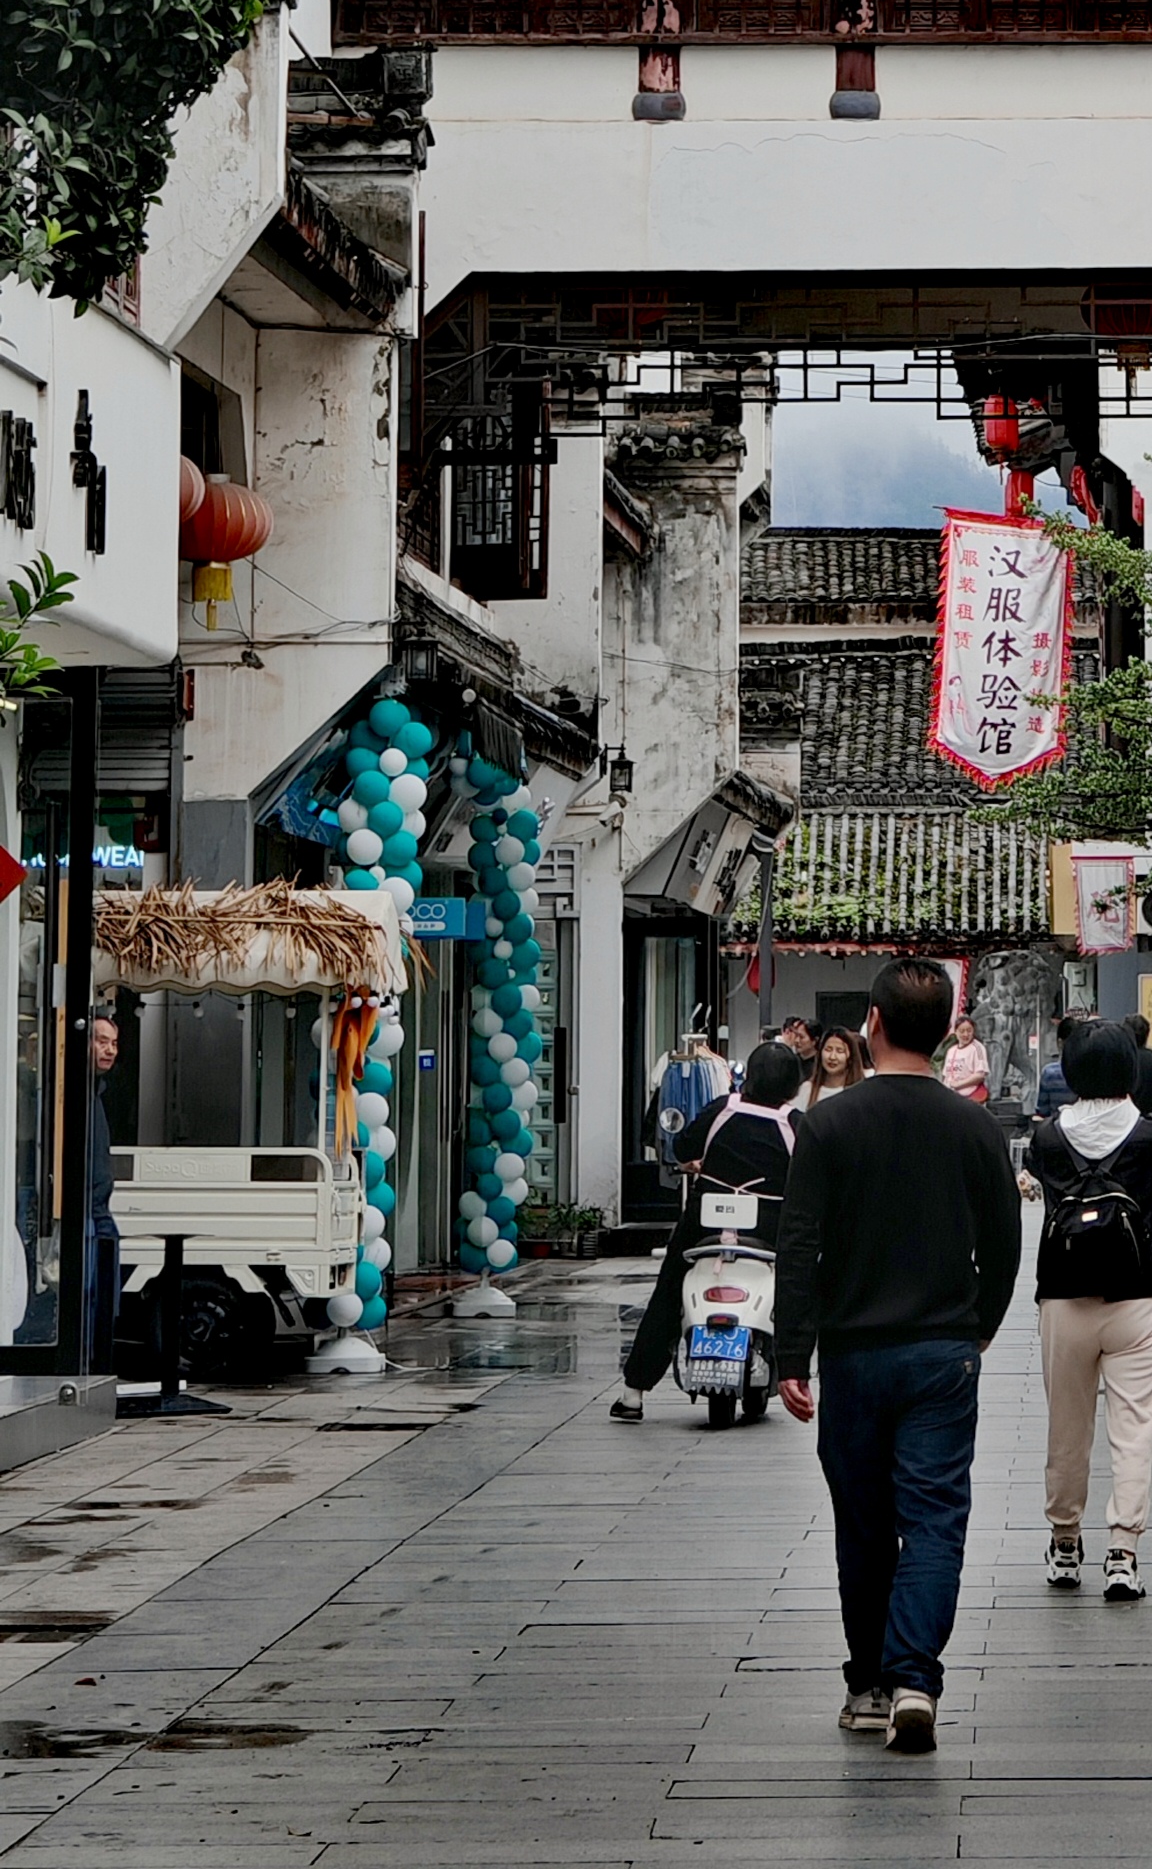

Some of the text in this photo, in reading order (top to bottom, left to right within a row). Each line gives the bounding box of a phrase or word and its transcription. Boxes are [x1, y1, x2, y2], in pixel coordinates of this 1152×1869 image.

[954, 549, 980, 650] 服装租赁
[975, 545, 1029, 756] 汉服体验馆
[693, 1340, 744, 1358] 46276
